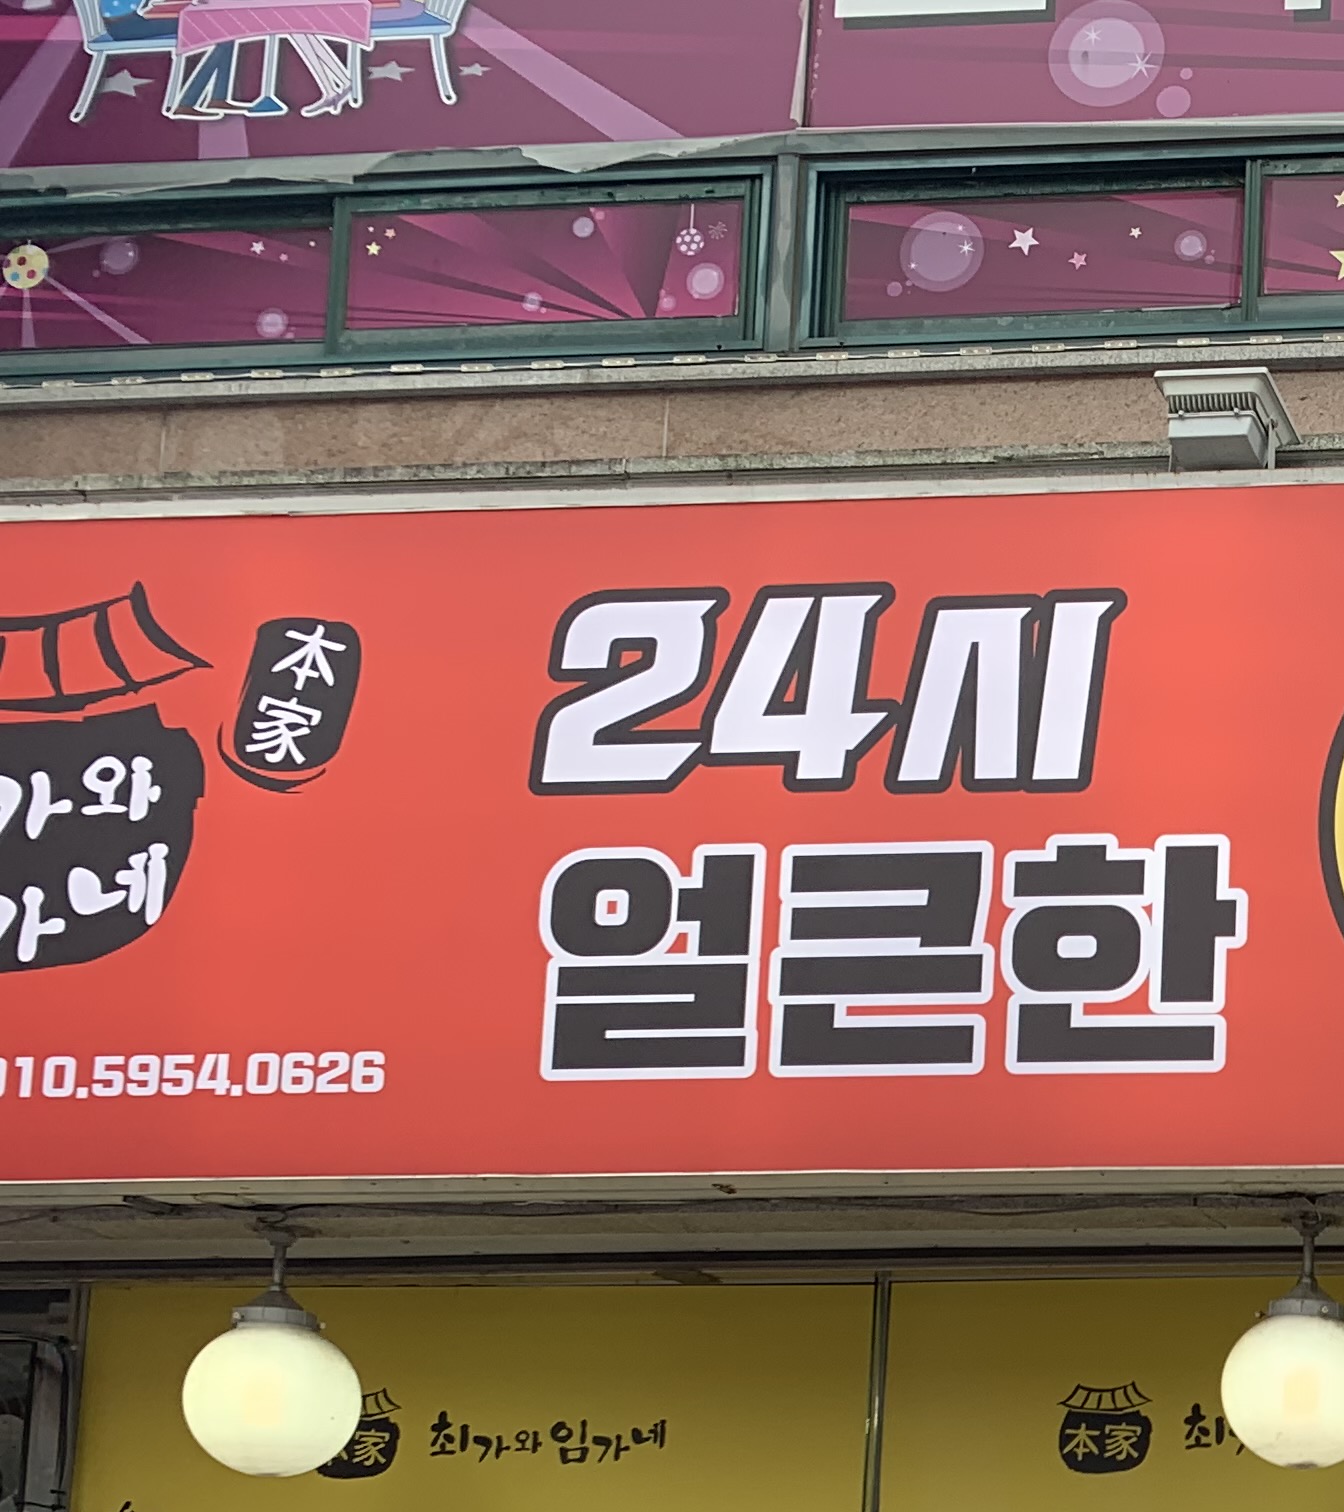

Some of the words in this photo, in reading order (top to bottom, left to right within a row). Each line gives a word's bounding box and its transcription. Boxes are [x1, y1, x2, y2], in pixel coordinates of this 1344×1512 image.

[531, 583, 1127, 794] 24시
[539, 833, 1248, 1081] 얼큰한
[0, 1050, 386, 1100] 10.5954.0626
[328, 1427, 388, 1467] 家
